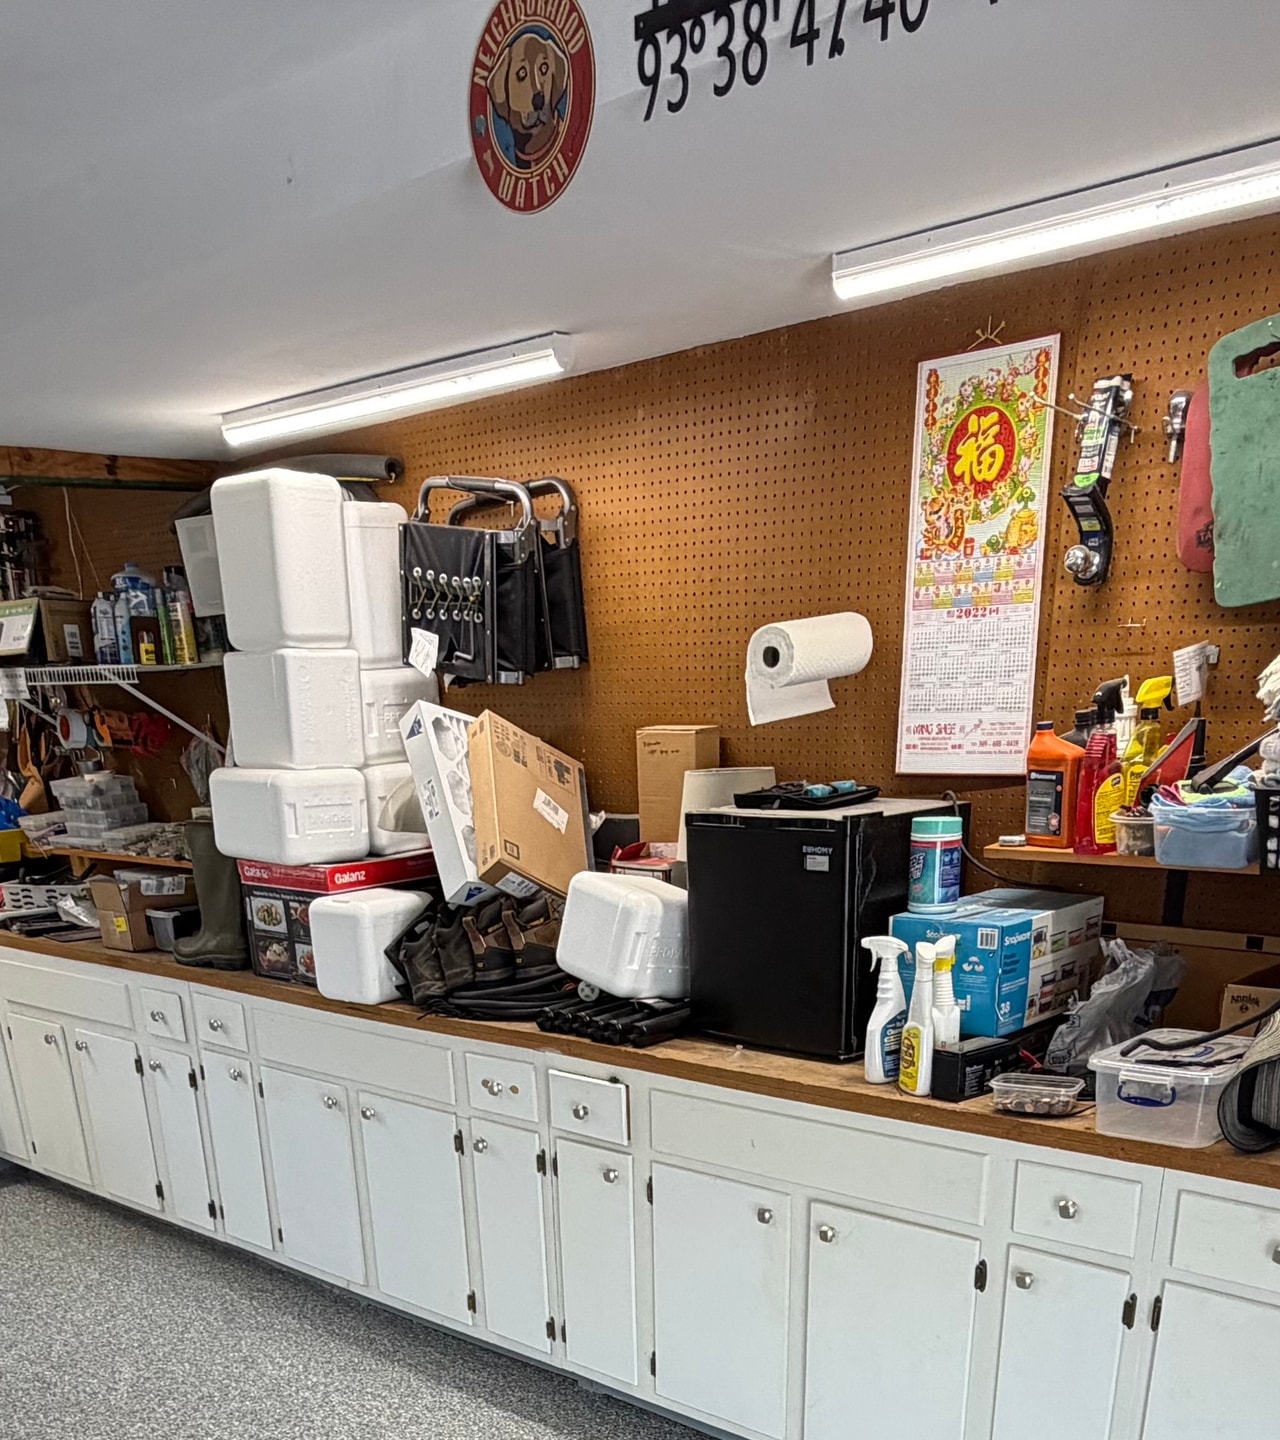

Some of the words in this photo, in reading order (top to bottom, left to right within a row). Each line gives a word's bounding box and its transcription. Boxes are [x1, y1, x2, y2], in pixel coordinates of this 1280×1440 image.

[498, 152, 570, 207] WATCH
[953, 411, 1005, 485] 福
[955, 607, 987, 619] 2022
[334, 870, 366, 884] Galanz
